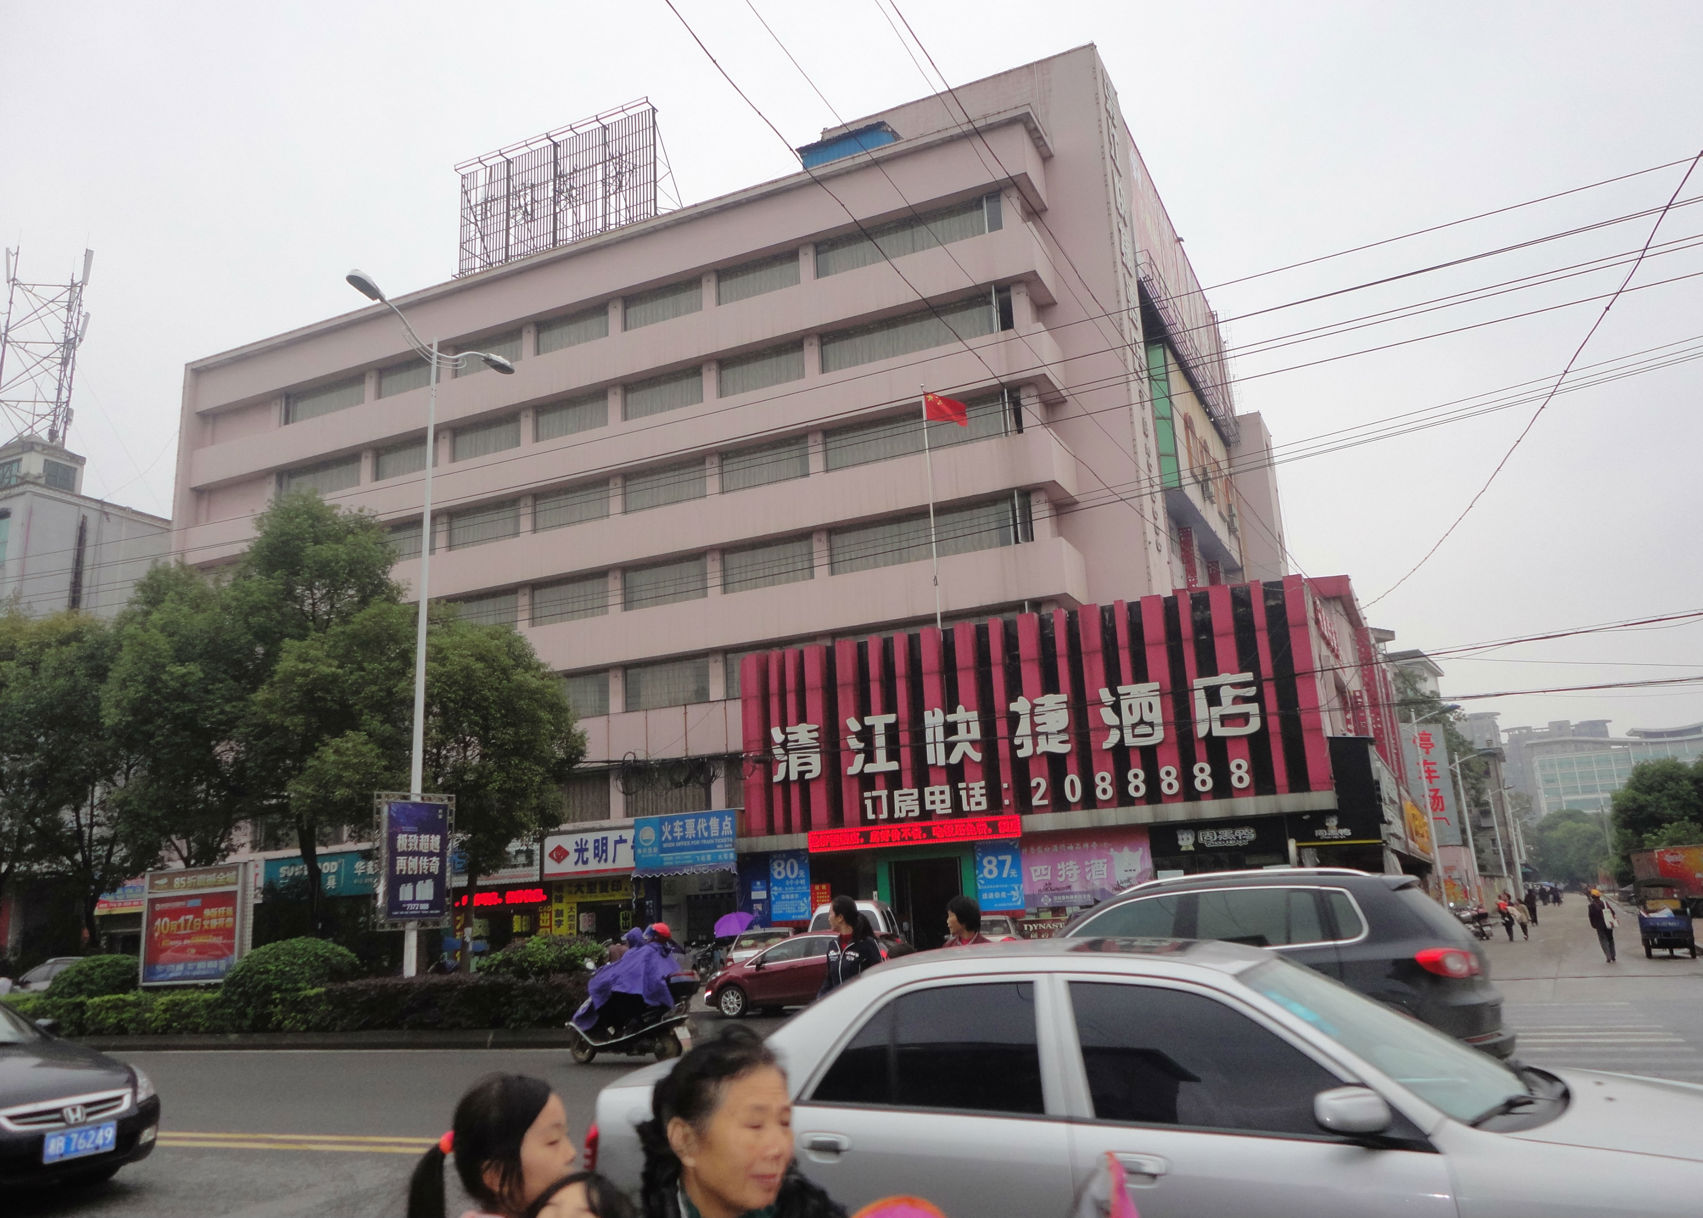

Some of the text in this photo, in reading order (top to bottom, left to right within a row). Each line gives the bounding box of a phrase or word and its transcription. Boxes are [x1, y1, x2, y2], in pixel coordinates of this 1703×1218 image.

[771, 672, 1261, 783] 清江快捷酒店
[1412, 730, 1446, 813] 停车场
[662, 816, 733, 841] 火车票代售点
[396, 833, 441, 853] 极致超越
[574, 834, 636, 866] 光明广
[395, 856, 440, 875] 再创传奇
[1029, 858, 1108, 883] 四特酒
[154, 914, 202, 936] 10月17日
[1023, 921, 1065, 931] DYNAST
